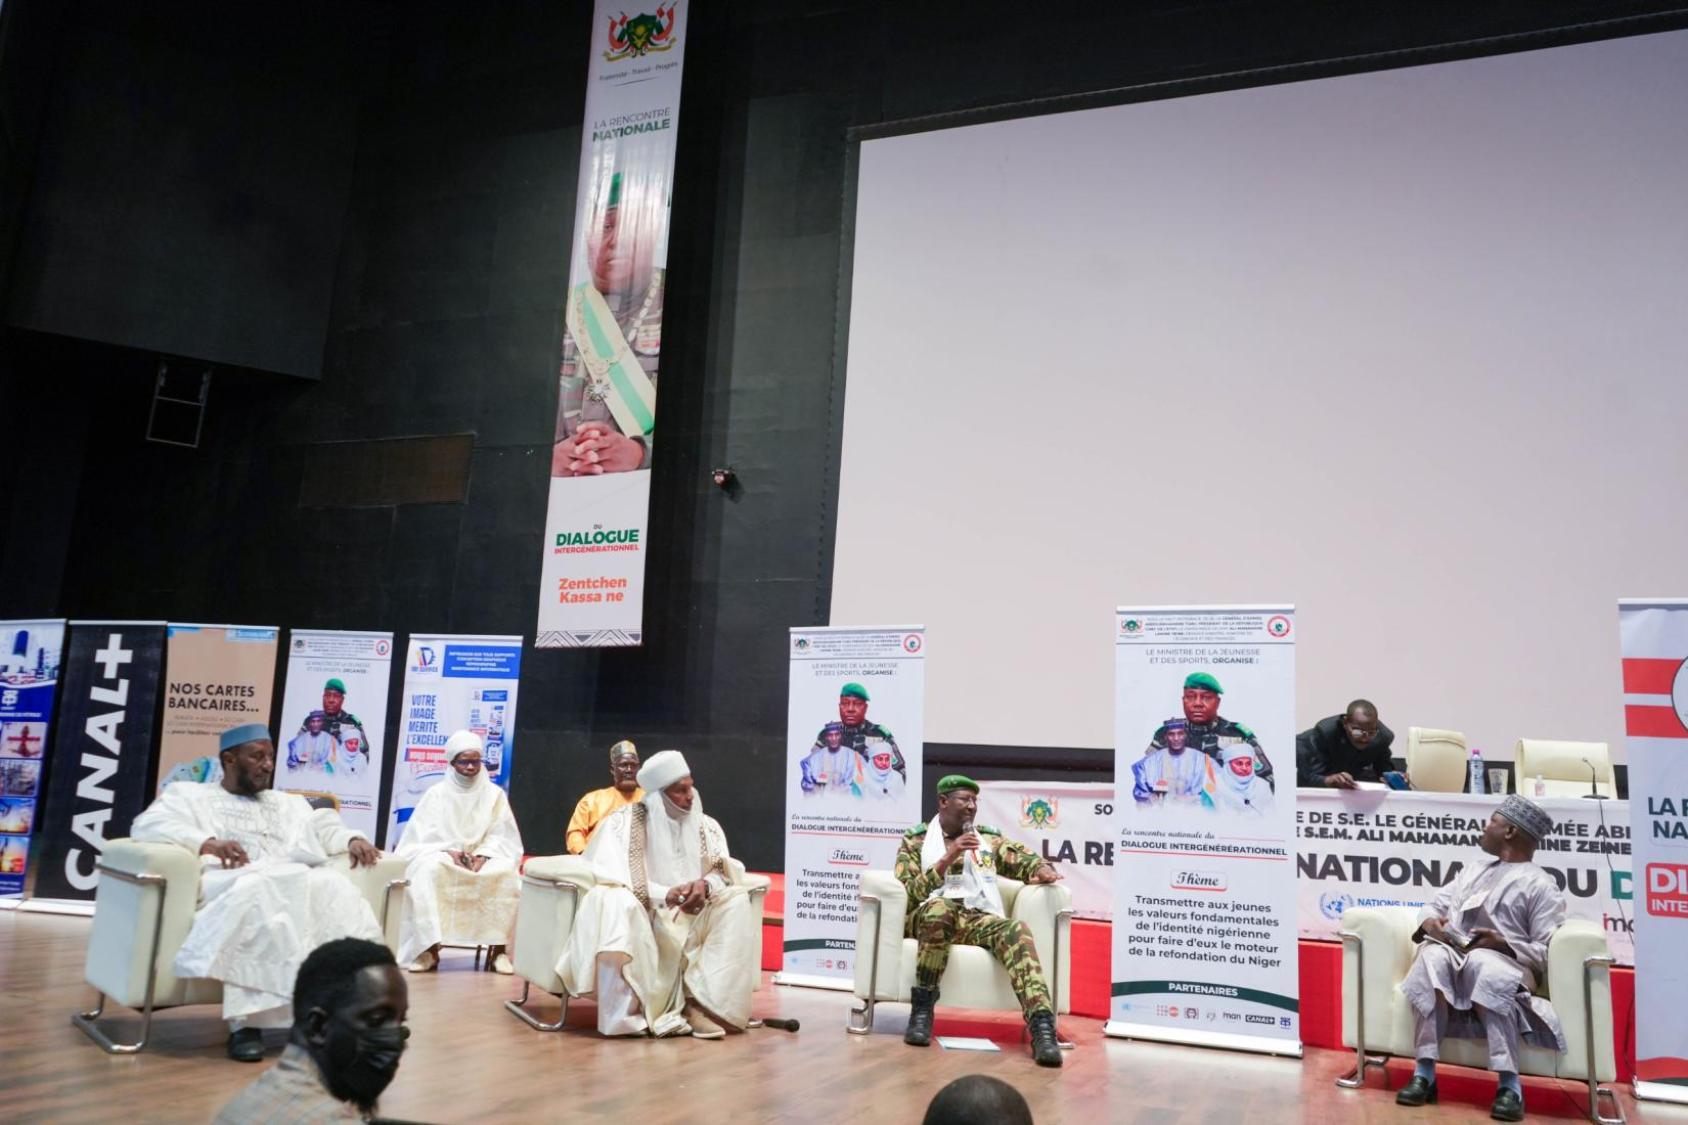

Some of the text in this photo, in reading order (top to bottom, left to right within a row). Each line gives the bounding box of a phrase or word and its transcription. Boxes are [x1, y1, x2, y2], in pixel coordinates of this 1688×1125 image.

[593, 107, 671, 130] LA RENCONTRE
[592, 118, 671, 142] NATIONALE
[556, 529, 639, 546] DIALOGUE
[559, 576, 627, 590] Zentchen
[560, 592, 624, 603] Kassa ne
[1157, 648, 1194, 656] MINISTRE
[170, 683, 255, 697] NOS CARTES
[411, 695, 437, 707] VOTRE
[410, 708, 435, 720] IMAGE
[407, 734, 449, 745] L'EXCELLEN
[65, 634, 133, 891] CANAL+
[1648, 797, 1678, 816] LA
[1094, 804, 1114, 815] SO
[1309, 812, 1333, 825] DE
[1338, 813, 1369, 826] S.E.
[1375, 814, 1397, 828] LE
[791, 824, 826, 832] DIALOGUE
[1653, 820, 1688, 839] NA
[1168, 831, 1202, 840] nationale
[1204, 832, 1215, 840] du
[1304, 827, 1352, 840] S.E.M.
[1357, 829, 1384, 842] ALI
[1389, 831, 1482, 847] MAHAMAN
[1576, 840, 1632, 855] ZEINE
[1121, 840, 1168, 850] DIALOGUE
[832, 850, 864, 861] Thème
[1042, 839, 1078, 864] LA
[1084, 841, 1114, 866] RE
[1297, 852, 1464, 887] NATIONA
[802, 869, 853, 880] Transmettre
[1176, 871, 1219, 887] Thème
[1650, 868, 1687, 895] DI
[810, 881, 840, 889] valeurs
[815, 890, 852, 900] l'identité
[797, 901, 857, 912] pour faire d'eu
[1135, 895, 1272, 913] Transmettre aux jeunes
[1651, 899, 1688, 913] INTE
[809, 912, 816, 920] la
[818, 913, 857, 923] refondati
[1128, 907, 1280, 927] les valeurs fondamentales
[1135, 921, 1271, 940] de l'identité nigérienne
[825, 940, 856, 949] PARTEN
[1128, 935, 1280, 953] pour faire d'eux le moteur
[1128, 947, 1282, 969] de la refondation du Niger
[1168, 982, 1239, 997] PARTENAIRES
